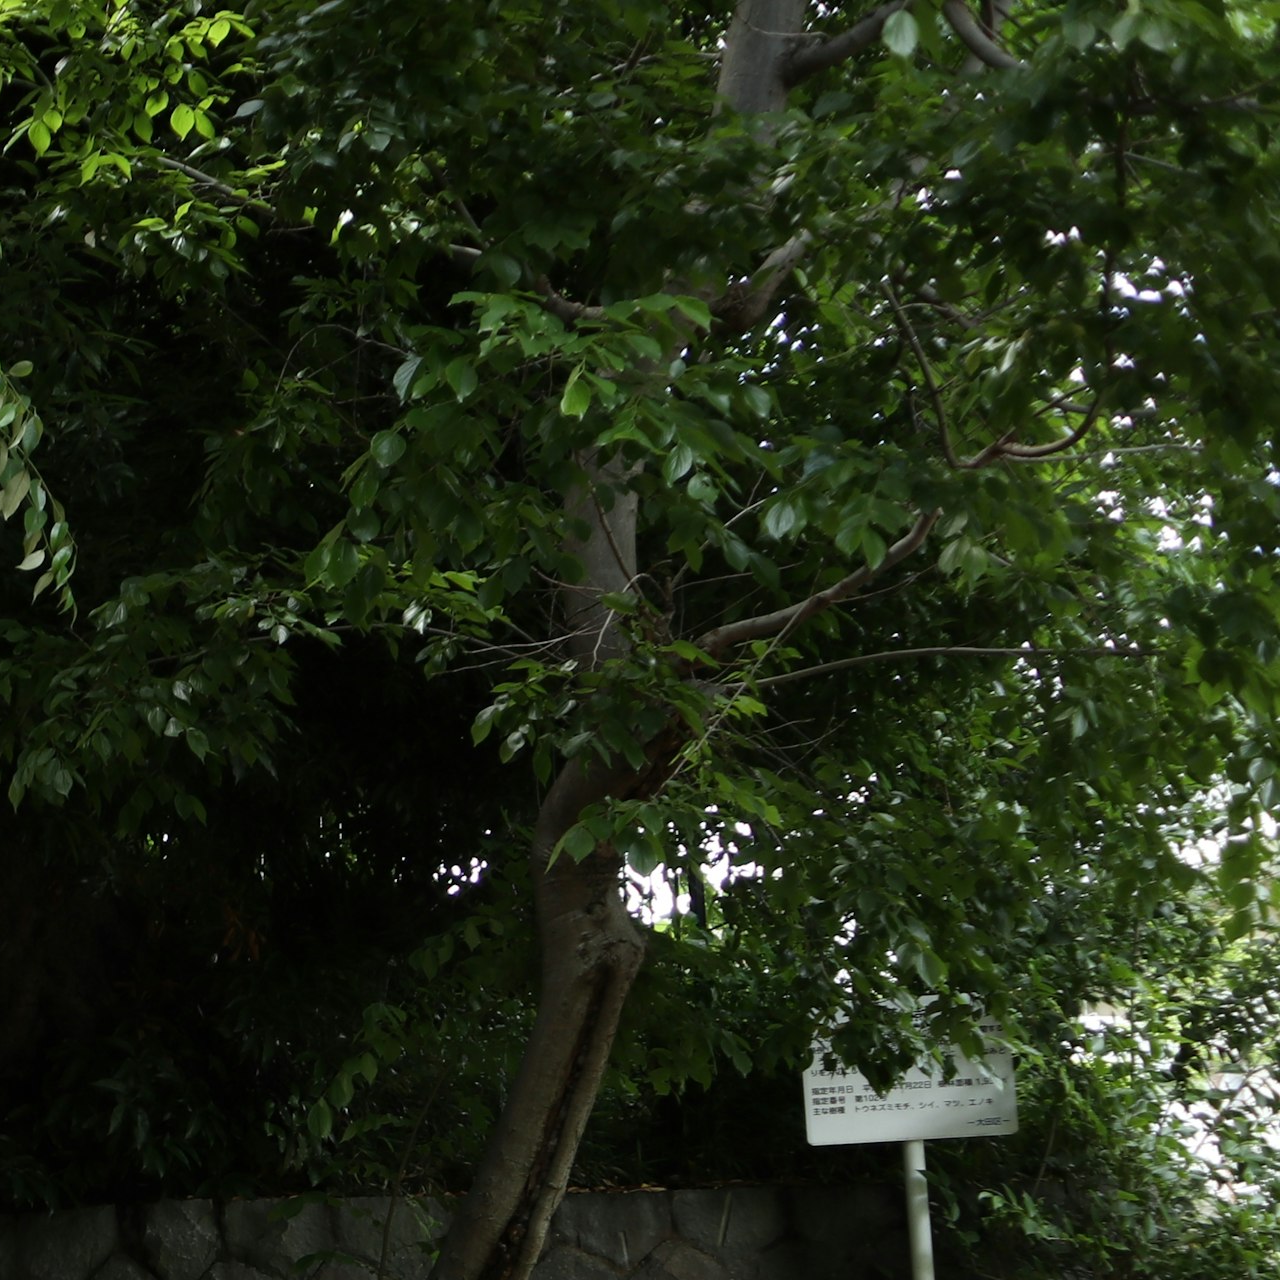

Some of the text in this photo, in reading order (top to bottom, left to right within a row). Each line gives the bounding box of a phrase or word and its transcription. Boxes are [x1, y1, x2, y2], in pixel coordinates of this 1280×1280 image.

[811, 1084, 855, 1096] 指定年月日
[811, 1095, 846, 1106] 指定番号
